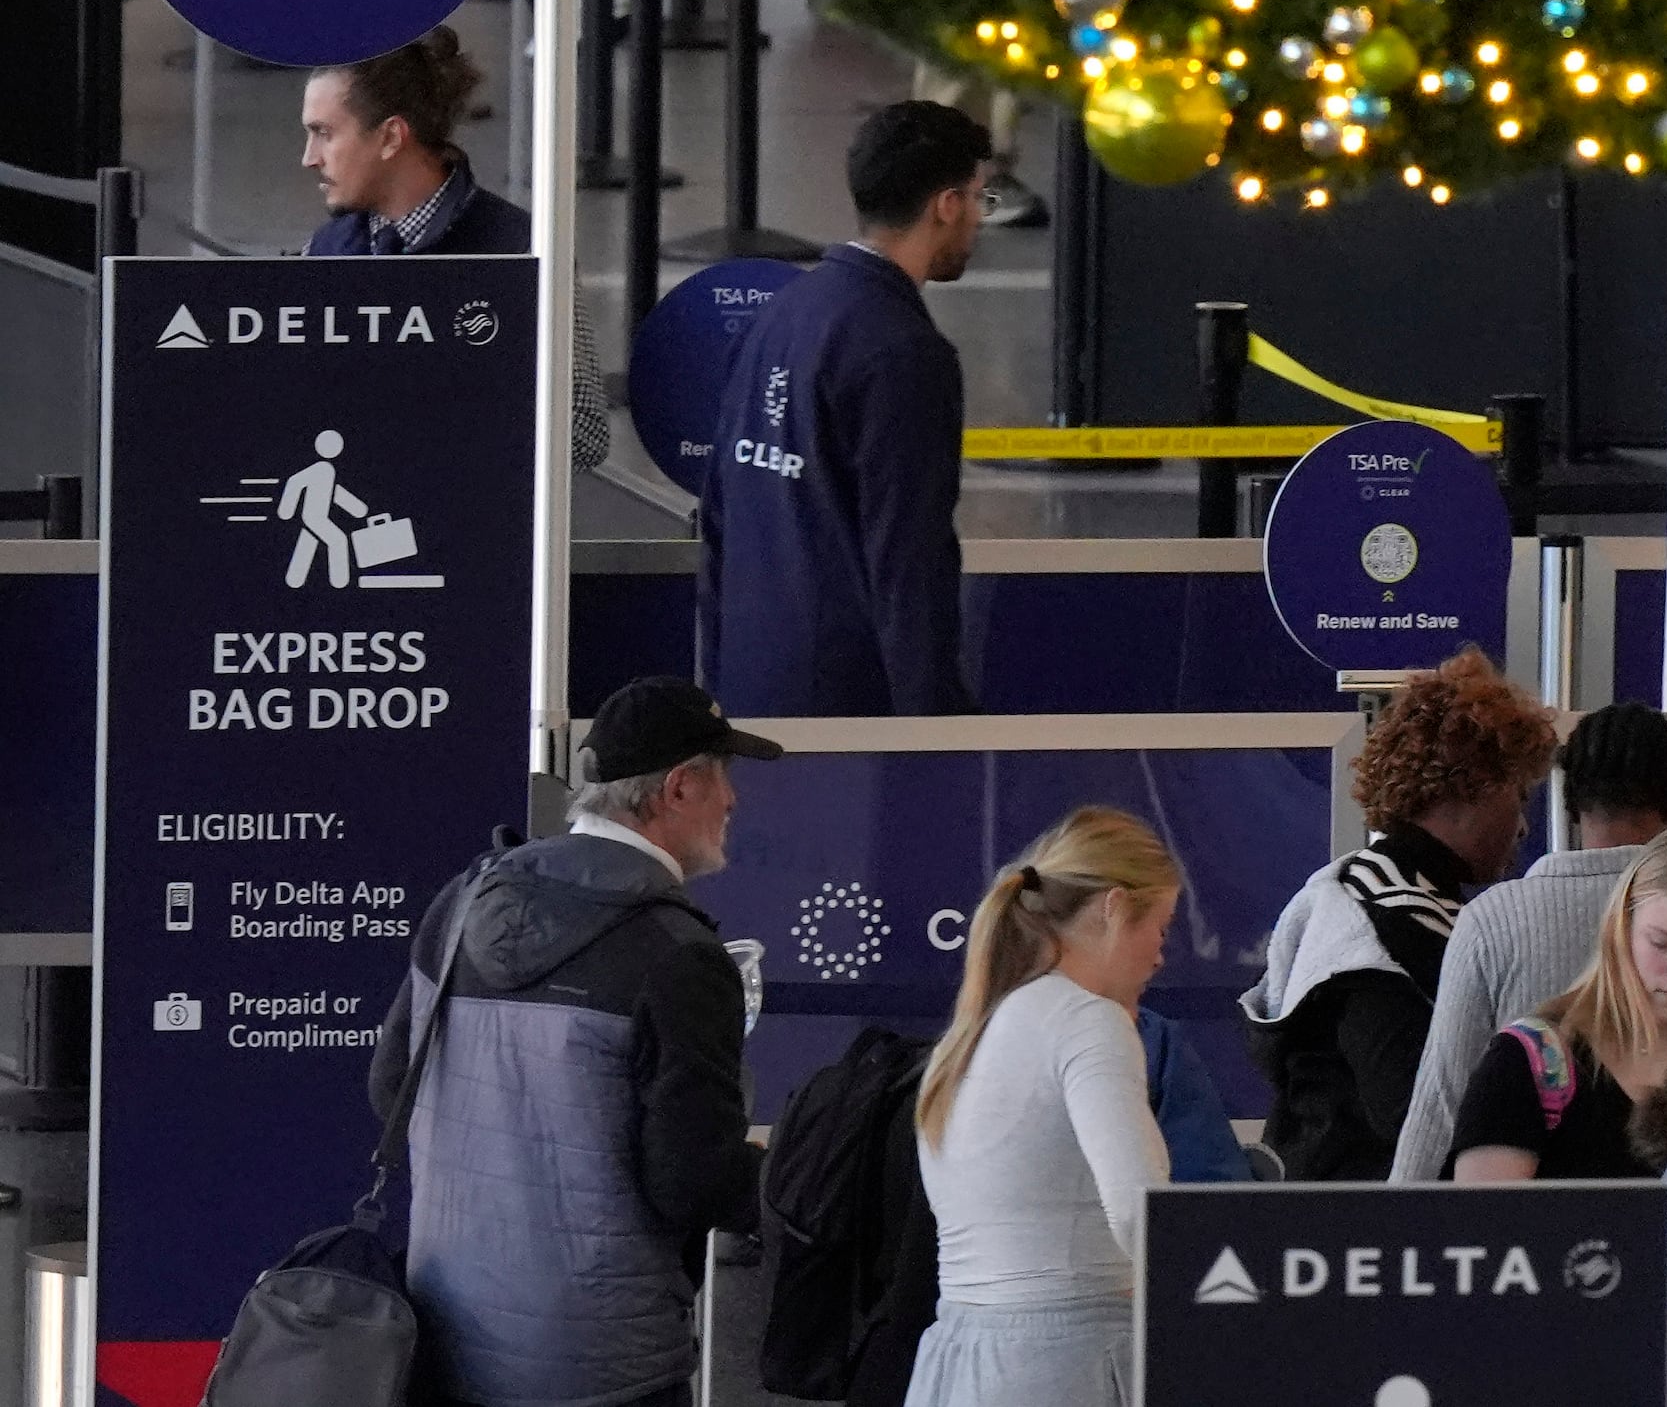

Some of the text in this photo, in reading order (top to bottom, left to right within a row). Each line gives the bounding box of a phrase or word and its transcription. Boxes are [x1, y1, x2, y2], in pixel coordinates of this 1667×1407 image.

[713, 288, 744, 305] TSA
[228, 306, 434, 344] DELTA
[1348, 454, 1410, 471] TSA Pre
[1317, 613, 1459, 629] Renew and Save
[213, 631, 426, 673] EXPRESS
[189, 687, 449, 730] BAG DROP
[157, 813, 345, 842] ELIGIBILITY:
[230, 880, 405, 910] Fly Delta App
[230, 913, 411, 943] Boarding Pass
[228, 990, 361, 1020] Prepaid or
[227, 1023, 383, 1052] Compliment
[1283, 1246, 1541, 1297] DELTA
